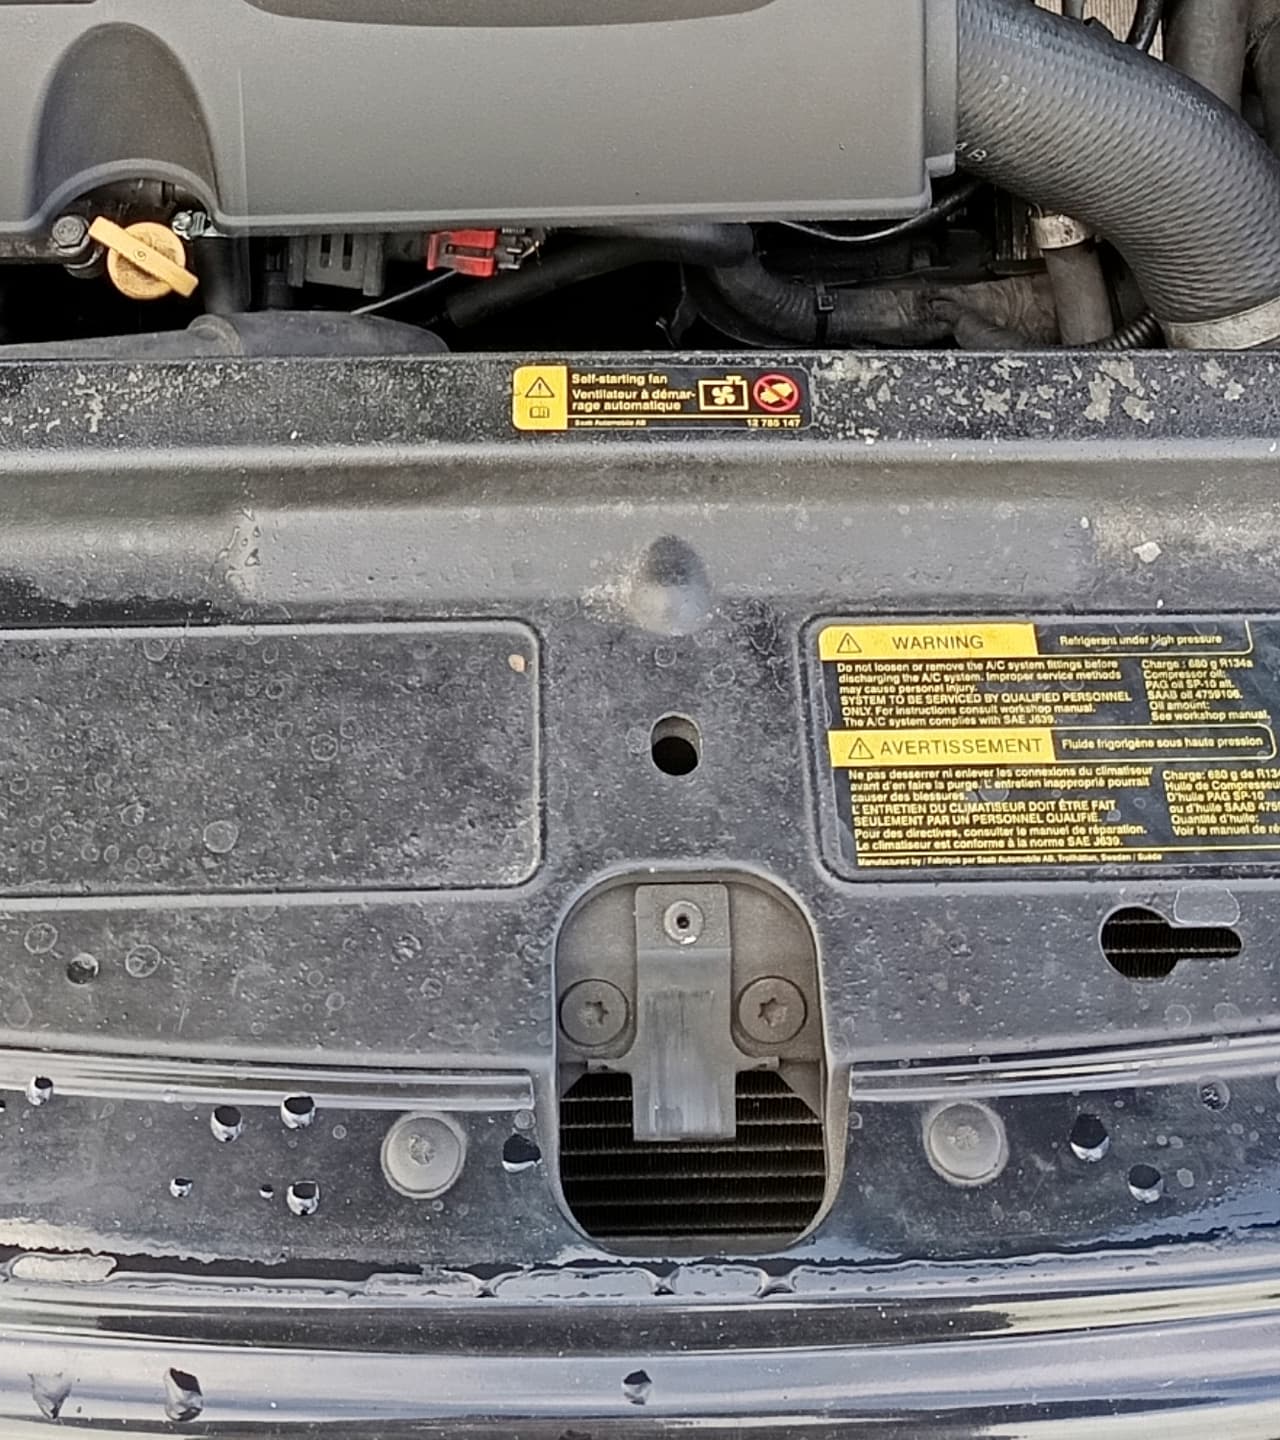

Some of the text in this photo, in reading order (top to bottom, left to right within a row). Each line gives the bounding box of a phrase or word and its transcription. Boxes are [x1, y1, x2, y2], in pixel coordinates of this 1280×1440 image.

[572, 373, 668, 386] Self-starting fan
[572, 388, 696, 400] Ventilateur à démar-
[572, 400, 681, 413] rage automatique
[783, 419, 800, 428] 147
[892, 635, 984, 650] WARNING
[837, 660, 1118, 672] Do not loosen or remove the A/C system fittings before
[1141, 660, 1179, 670] Charge
[839, 670, 1121, 684] discharging the A/C system. Improper service methods
[1143, 670, 1207, 680] Compressor
[839, 684, 978, 695] may cause personal injury.
[1145, 680, 1217, 689] PAG oil SP-10
[840, 692, 1133, 705] SYSTEM TO BE SERVICED BY QUALIFIED PERSONNEL
[1147, 690, 1193, 699] SAAB oil
[842, 704, 1096, 716] ONLY. For instructions consult workshop manual.
[1149, 701, 1165, 710] Oil
[843, 715, 1026, 728] The A/C system complies with SAE
[1151, 710, 1271, 722] See workshop manual.
[880, 738, 1042, 755] AVERTISSEMENT
[1062, 740, 1095, 750] Fluide
[1157, 740, 1181, 748] sous
[1184, 737, 1214, 748] haute
[1218, 737, 1264, 749] pression
[849, 766, 1153, 781] Ne pas desserrer ni enlever les connexions du climatiseur
[1240, 769, 1254, 779] de
[850, 782, 879, 791] avant
[908, 781, 932, 790] faire
[934, 781, 944, 790] la
[1108, 777, 1150, 788] pourrait
[1165, 781, 1193, 791] Huile
[1195, 781, 1209, 790] de
[851, 792, 968, 802] causer des blessures.
[1207, 791, 1231, 801] PAG
[1233, 791, 1265, 801] SP-10
[929, 798, 1116, 813] DU CLIMATISEUR DOIT ÊTRE FAIT
[1169, 804, 1184, 813] ou
[1224, 801, 1256, 812] SAAB
[853, 813, 1044, 827] SEULEMENT PAR UN PERSONNEL
[854, 829, 881, 839] Pour
[883, 828, 903, 838] des
[963, 826, 1014, 837] consulter
[1016, 826, 1027, 835] le
[1029, 826, 1069, 835] manuel
[1072, 825, 1086, 834] de
[1172, 825, 1195, 836] Voir
[1196, 825, 1207, 835] le
[1209, 824, 1250, 835] manuel
[1252, 824, 1267, 833] de
[856, 836, 1091, 851] Le climatiseur est conforme à la norme SAE
